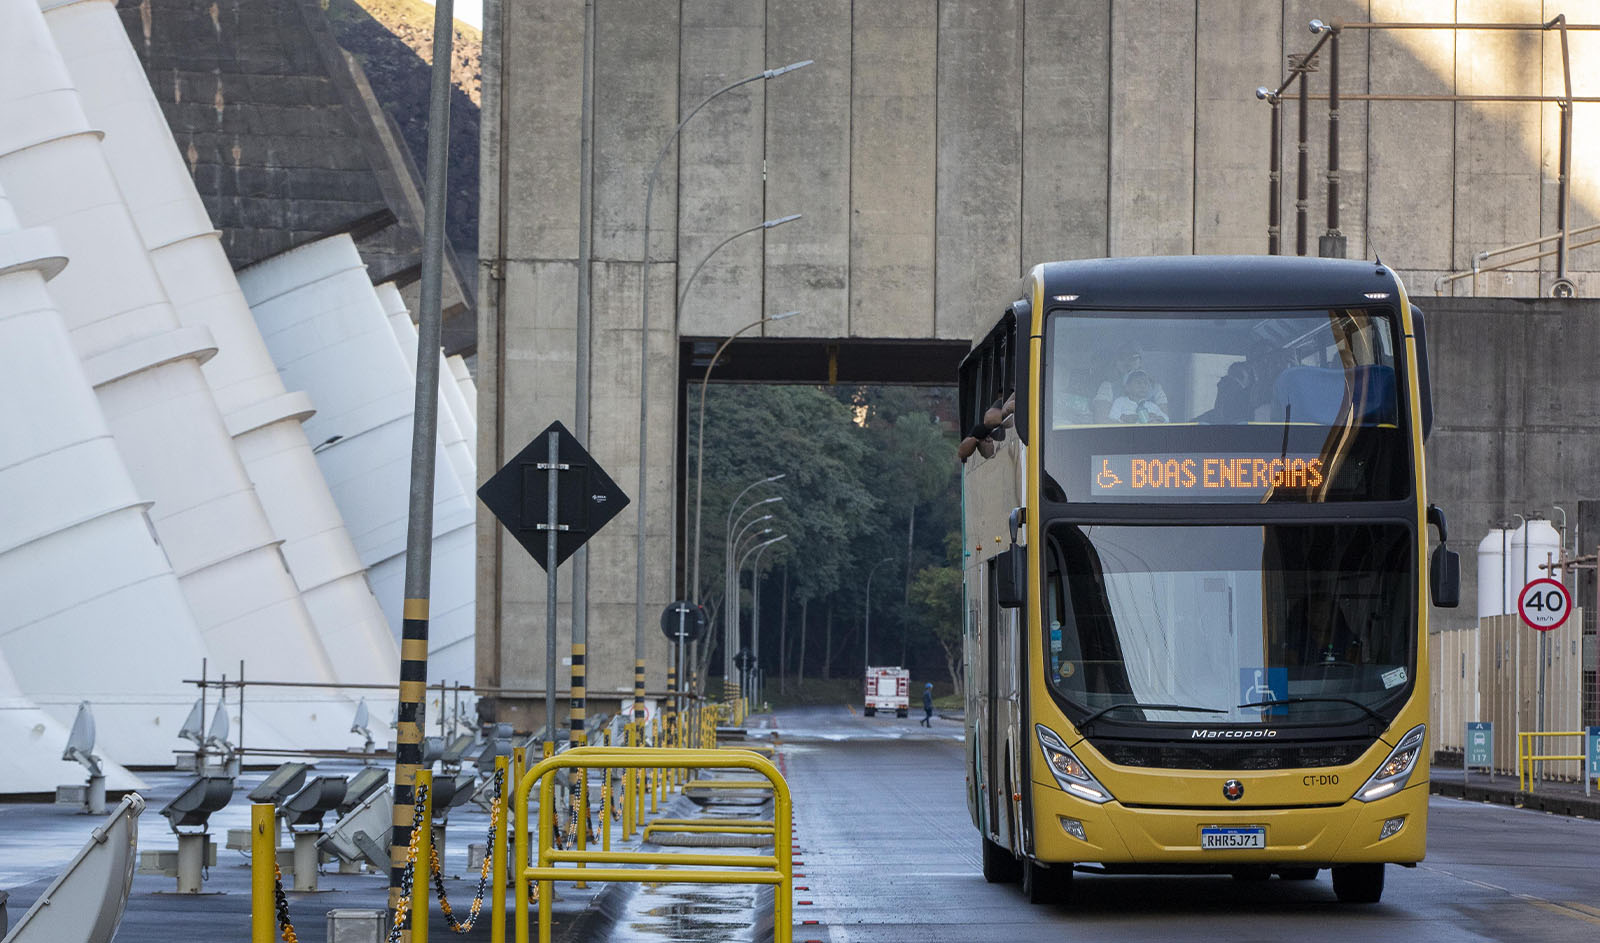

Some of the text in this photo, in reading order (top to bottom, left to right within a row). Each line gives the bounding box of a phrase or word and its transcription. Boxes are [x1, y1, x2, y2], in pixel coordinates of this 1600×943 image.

[1131, 458, 1323, 488] BOAS ENERGIAS
[1525, 590, 1563, 612] 40
[1191, 729, 1277, 739] Marcopolo
[1472, 753, 1487, 762] 117
[1302, 774, 1339, 786] CT-D10
[1207, 834, 1258, 847] RHR5J71
